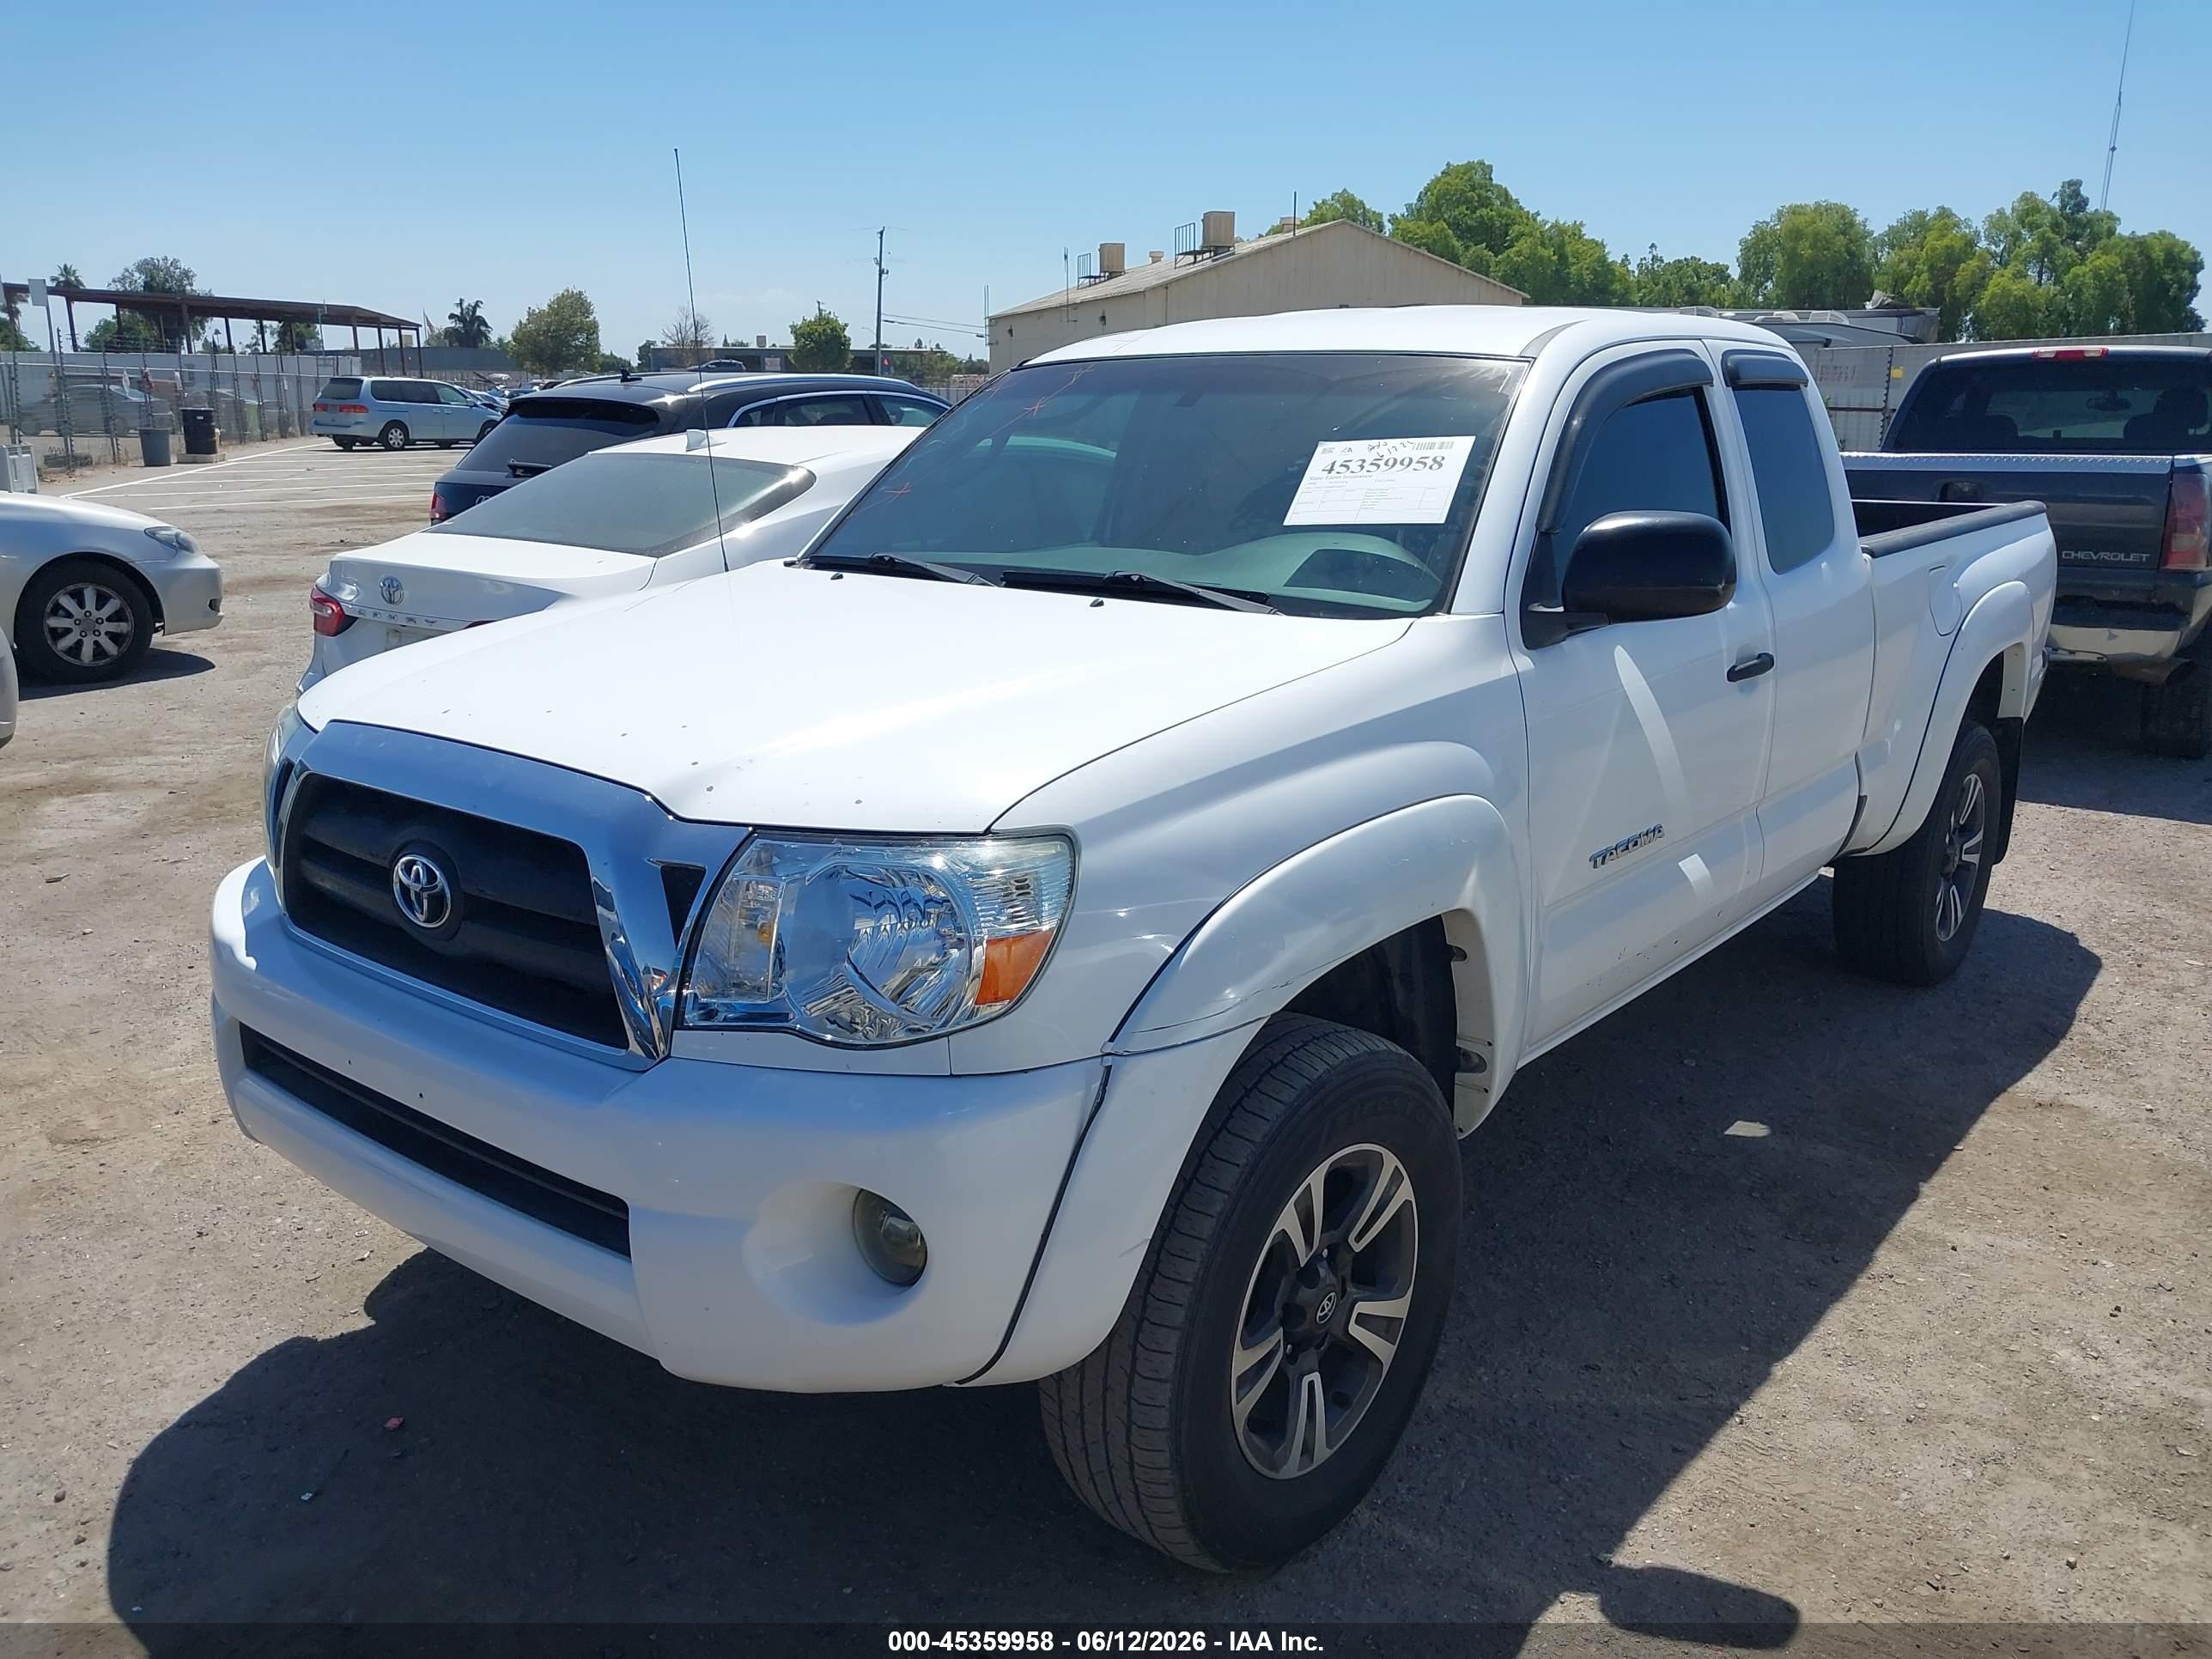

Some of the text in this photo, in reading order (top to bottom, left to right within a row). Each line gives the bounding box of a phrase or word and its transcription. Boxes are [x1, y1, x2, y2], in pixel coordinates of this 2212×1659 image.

[1321, 456, 1445, 474] 45359958
[2061, 550, 2151, 562] CHEVROLET
[1588, 823, 1664, 869] TACOMA
